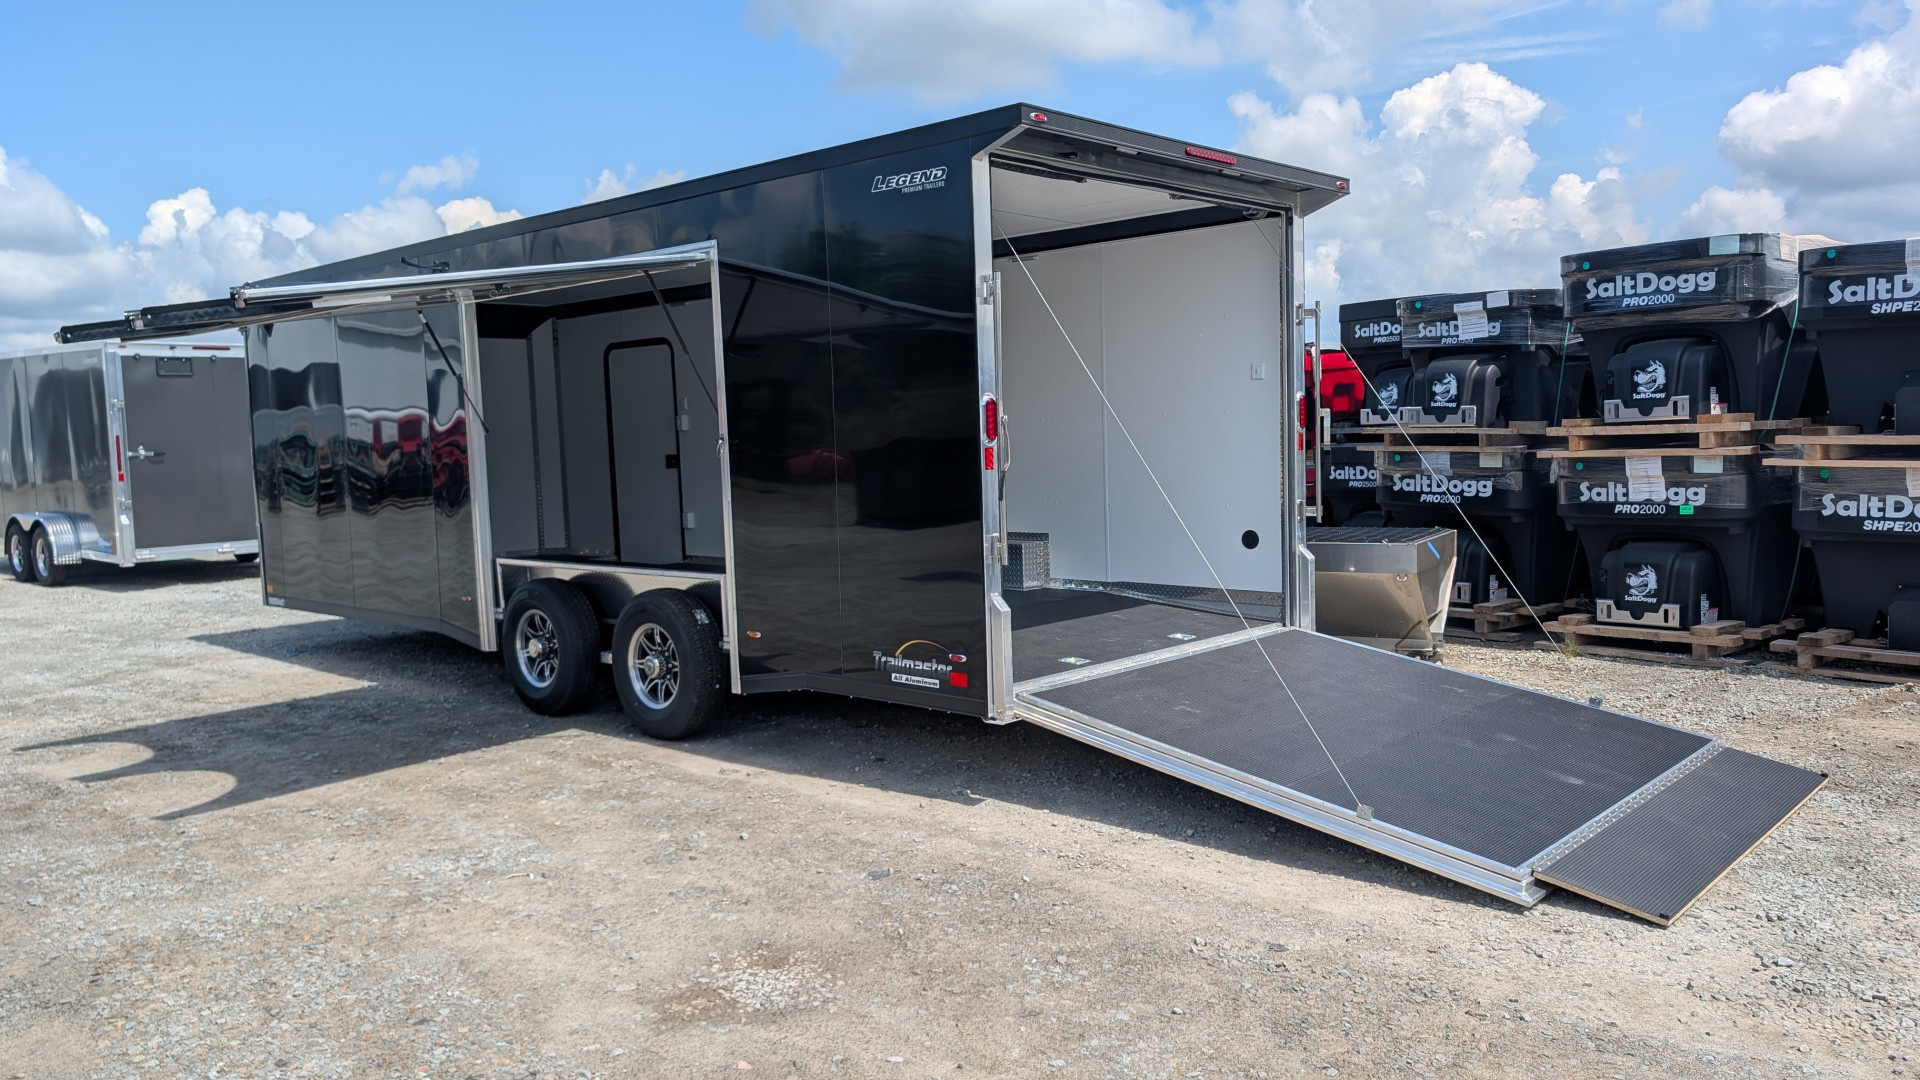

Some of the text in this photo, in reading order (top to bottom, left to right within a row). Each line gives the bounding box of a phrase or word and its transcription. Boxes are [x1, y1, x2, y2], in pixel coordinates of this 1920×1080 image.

[871, 166, 947, 192] LEGEND
[901, 181, 945, 194] PREMIUM TRAILERS
[1586, 272, 1716, 300] SaltDogg
[1622, 293, 1675, 307] PRO2000
[1373, 335, 1400, 344] PRO2500
[1633, 392, 1666, 400] SaltDogg
[1393, 472, 1493, 497] SaltDogg
[1420, 494, 1461, 504] PRO2000
[1580, 481, 1706, 506] Saltgg
[1614, 504, 1666, 514] PRO2000
[1863, 520, 1920, 532] SHPE20
[1624, 595, 1657, 603] SaltDogg
[873, 650, 953, 675] Trailmaster
[893, 674, 938, 687] All Aluminum
